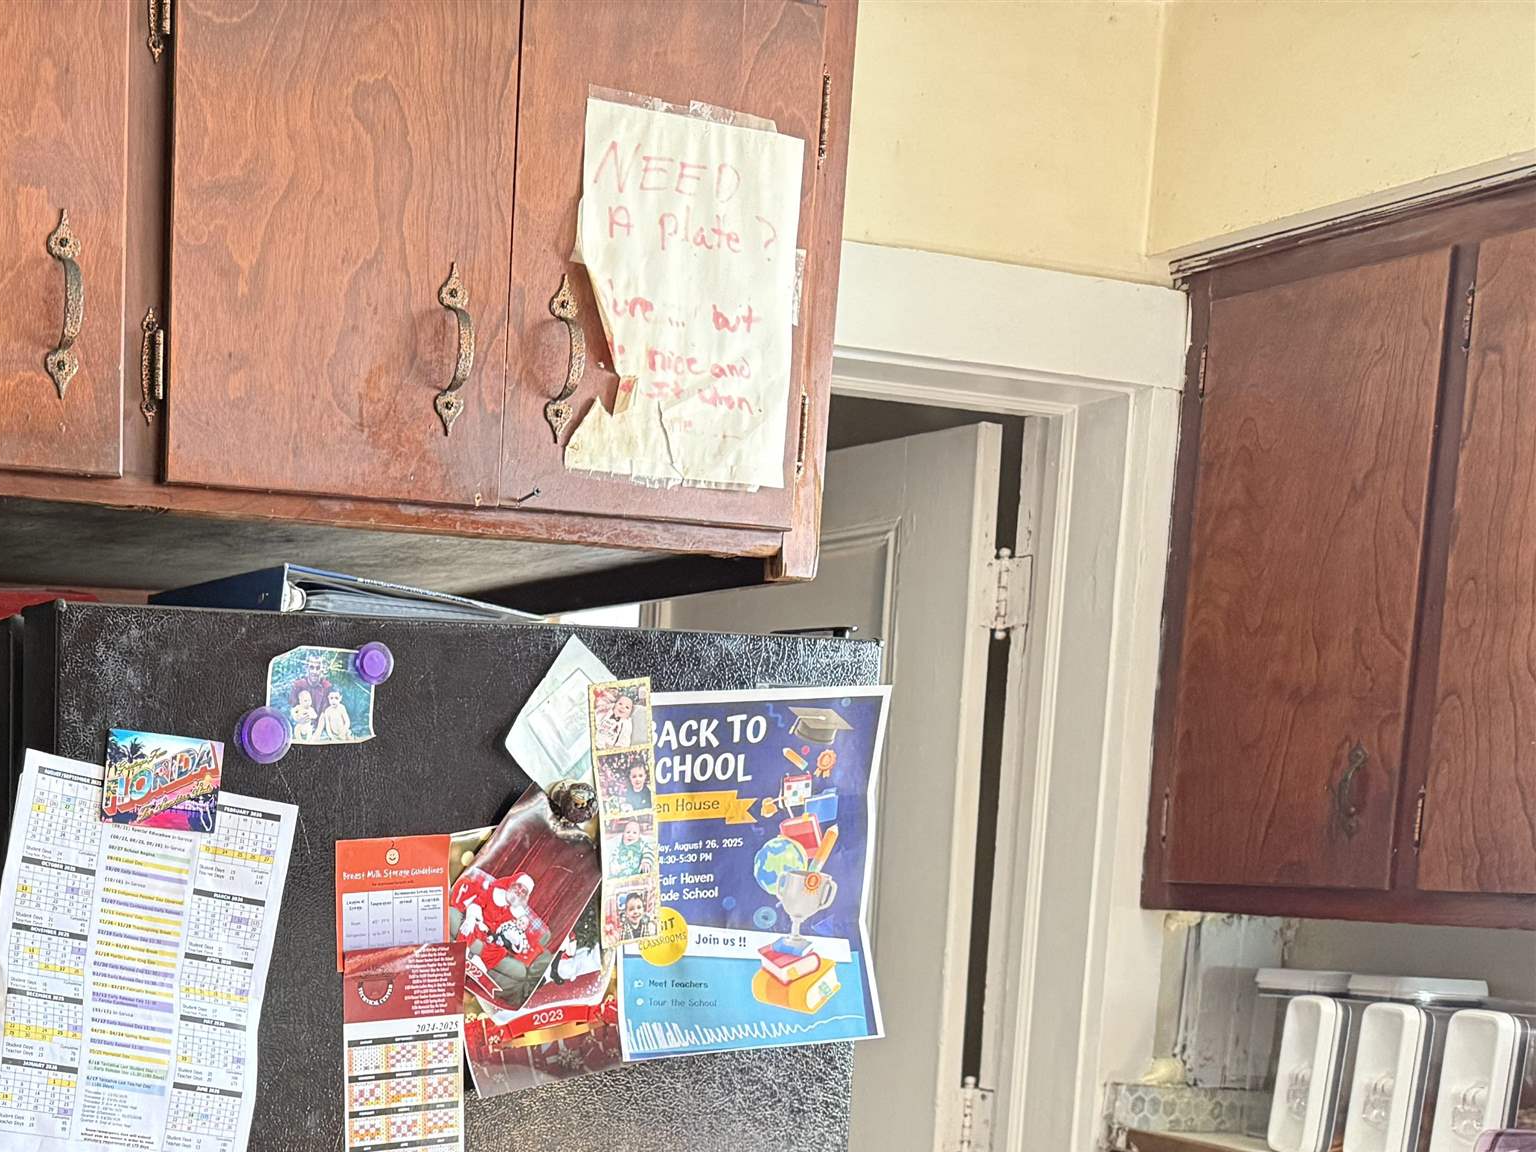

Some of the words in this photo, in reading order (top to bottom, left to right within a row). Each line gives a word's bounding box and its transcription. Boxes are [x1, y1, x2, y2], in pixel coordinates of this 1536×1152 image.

[594, 140, 741, 202] NEED
[608, 206, 633, 238] A
[727, 714, 766, 743] TO
[656, 753, 752, 784] CHOOL
[103, 740, 220, 816] FLORIDA
[224, 806, 250, 814] FEBRUARY
[656, 803, 670, 813] en
[676, 799, 720, 812] House
[674, 840, 702, 852] August
[722, 838, 743, 847] 2025
[700, 853, 712, 862] PM
[343, 872, 365, 880] Breast
[367, 870, 382, 879] Milk
[384, 869, 410, 878] Storage
[411, 867, 444, 876] Guidelines
[680, 873, 714, 884] Haven
[660, 889, 679, 901] ade
[683, 886, 719, 900] School
[695, 934, 719, 944] Join
[723, 938, 735, 946] us
[465, 962, 482, 978] 022
[649, 980, 667, 988] Meet
[672, 980, 708, 988] Teachers
[688, 999, 717, 1007] School
[533, 1009, 563, 1025] 2023
[416, 1021, 458, 1032] 2024-2025
